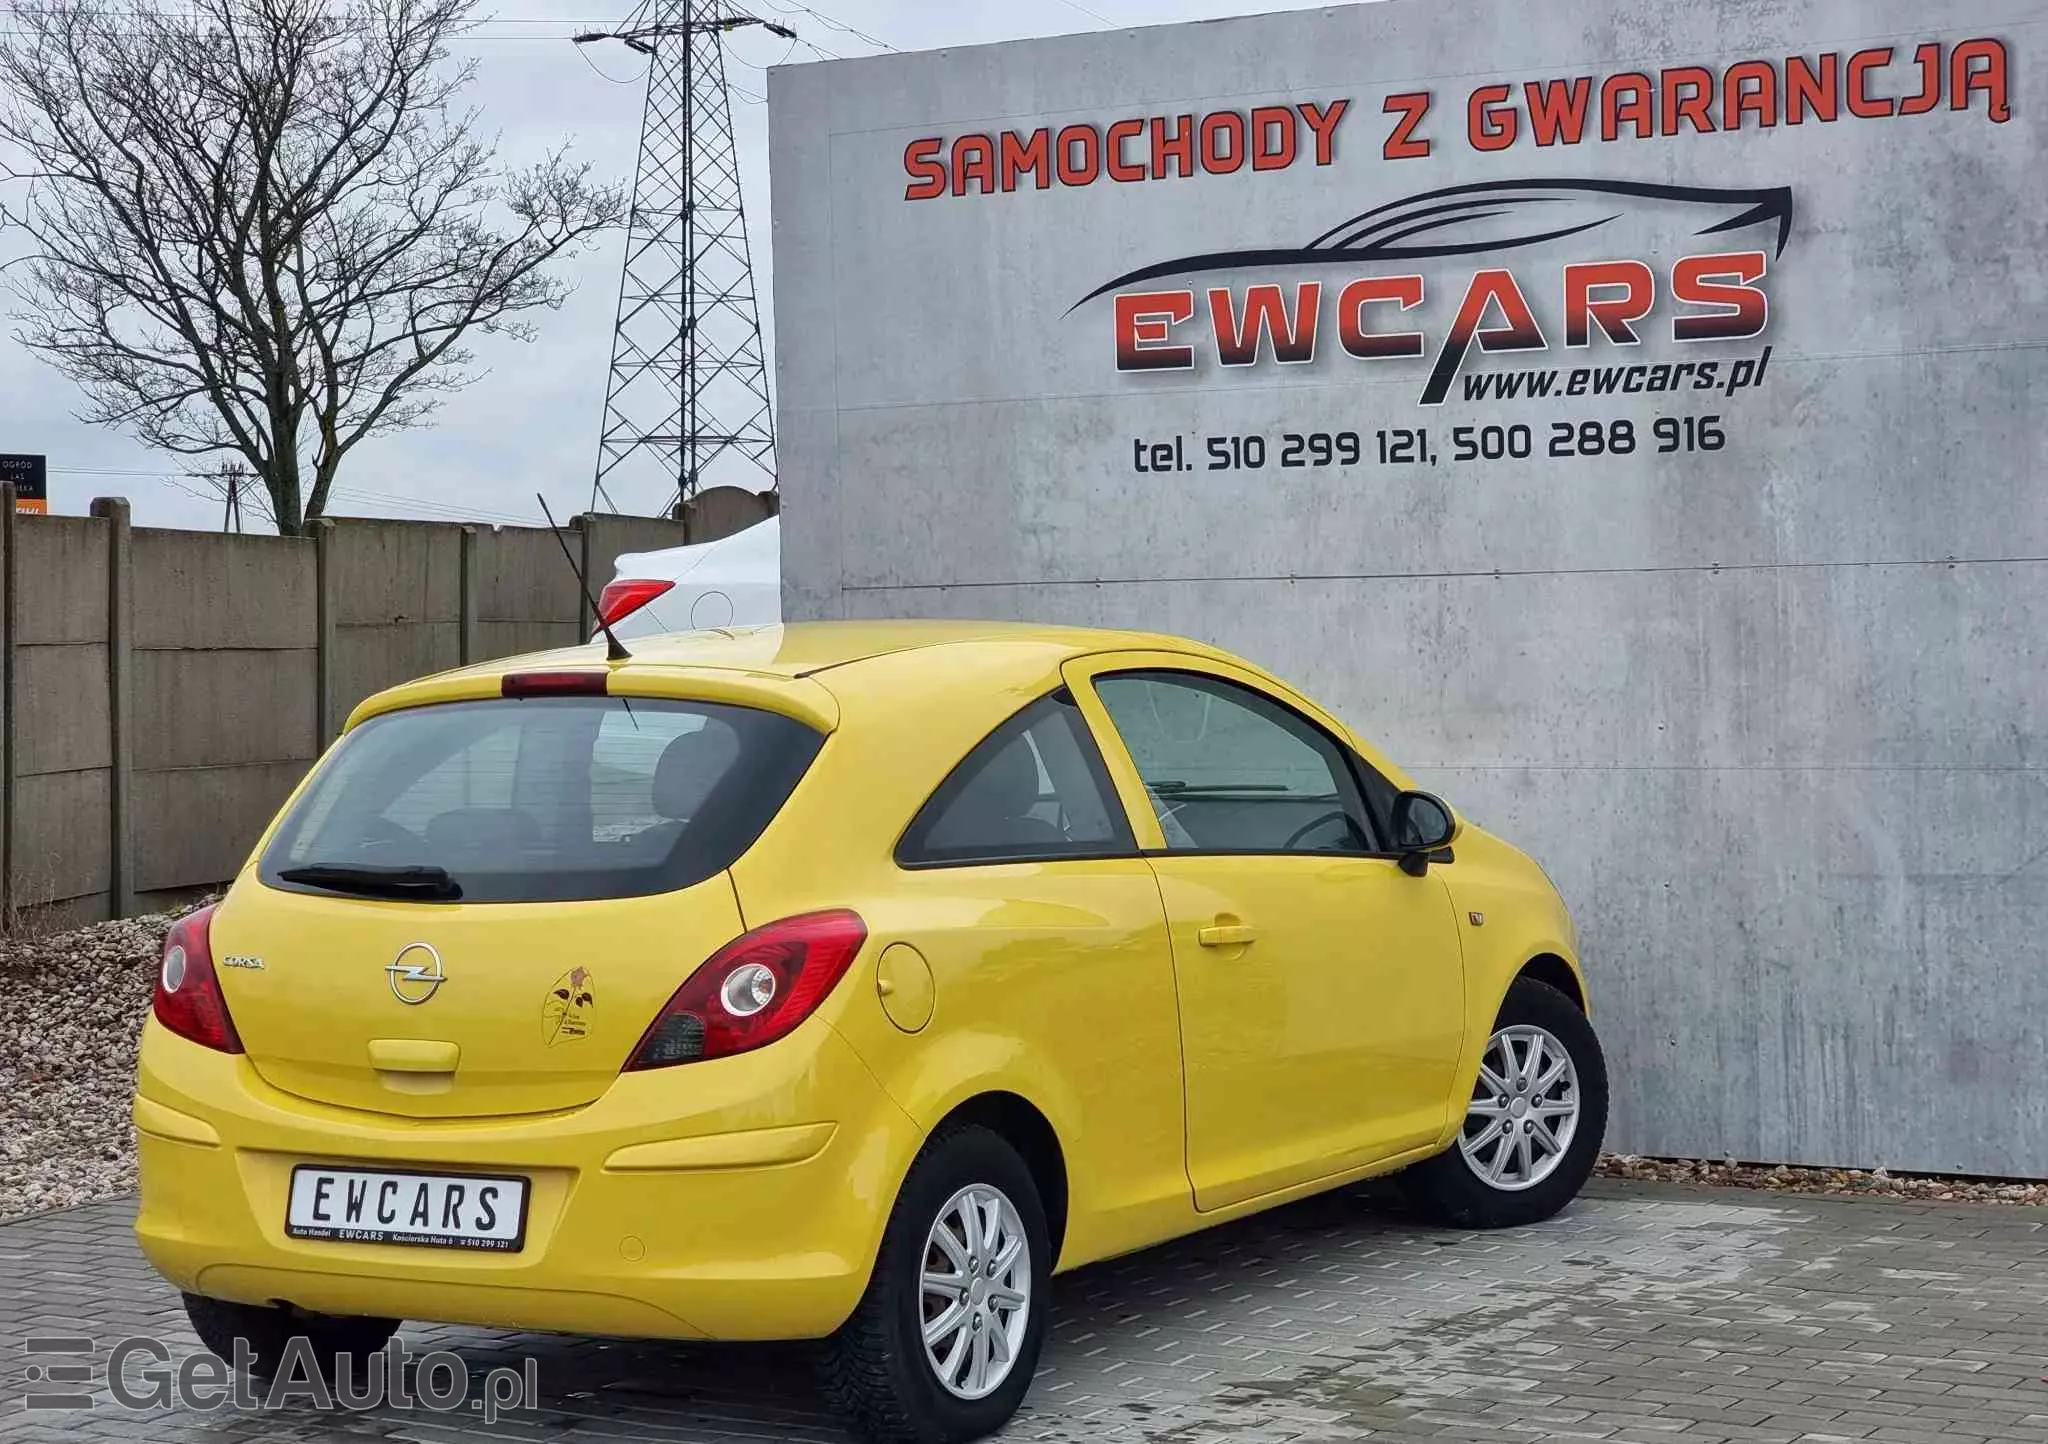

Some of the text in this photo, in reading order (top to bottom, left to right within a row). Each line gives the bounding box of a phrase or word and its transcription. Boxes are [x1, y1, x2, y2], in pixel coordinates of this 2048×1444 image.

[904, 36, 2012, 201] SAMOCHODY Z GWARANCJĄ
[1115, 252, 1770, 405] EWCARS
[1462, 350, 1772, 403] www.ewcars.pl
[1133, 417, 1728, 472] tel. 510 299 121, 500 288 916
[312, 1176, 499, 1231] EWCARS
[339, 1229, 384, 1241] EWCARS
[466, 1238, 480, 1247] 510
[481, 1239, 495, 1248] 299
[496, 1240, 509, 1249] 121
